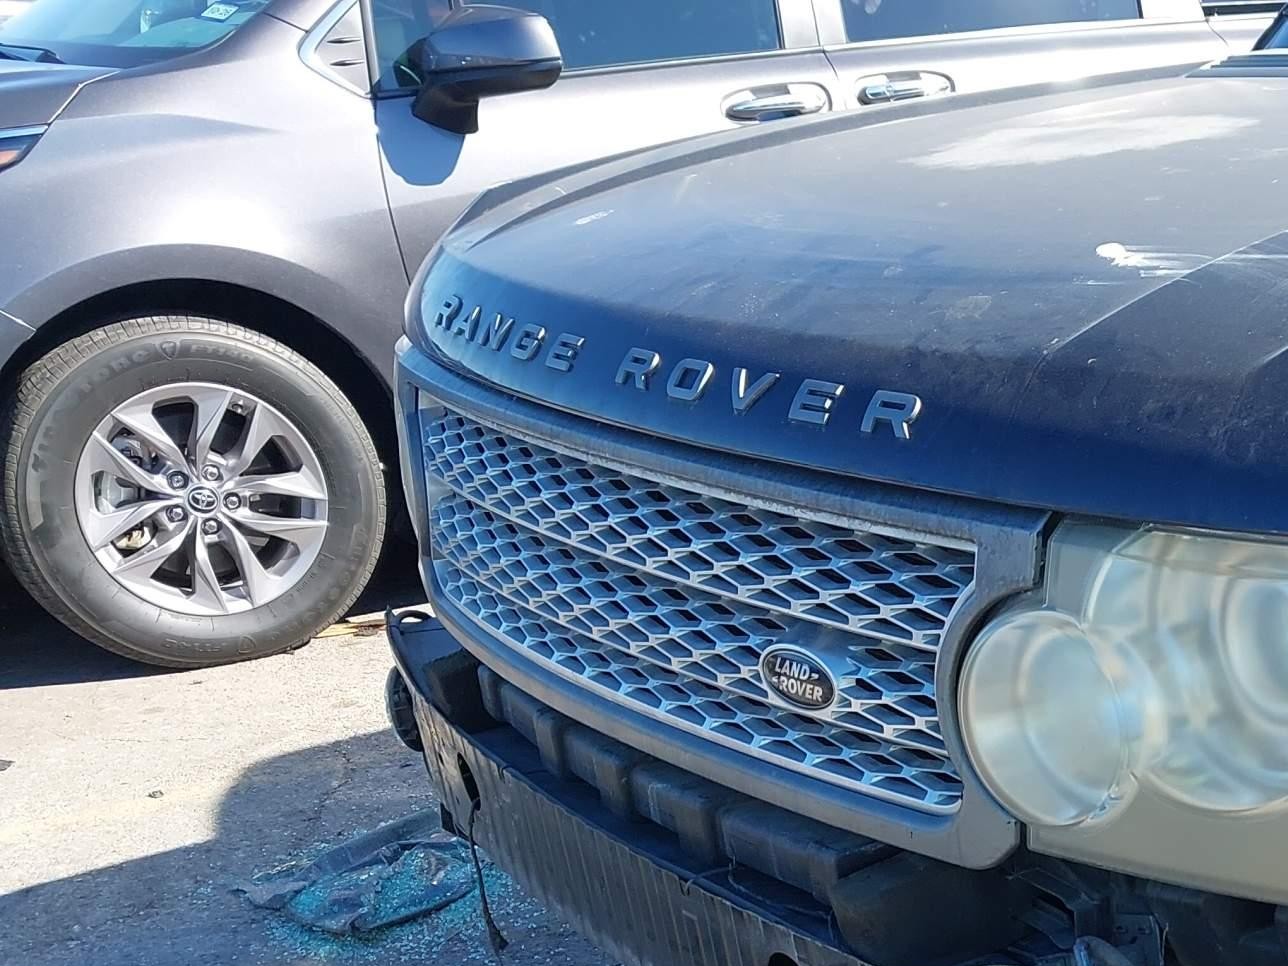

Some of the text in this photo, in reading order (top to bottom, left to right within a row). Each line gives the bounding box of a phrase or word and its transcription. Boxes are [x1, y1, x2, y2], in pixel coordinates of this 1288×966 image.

[434, 294, 923, 440] RANGE ROVER
[774, 656, 811, 681] LAND
[779, 676, 823, 702] ROVER
